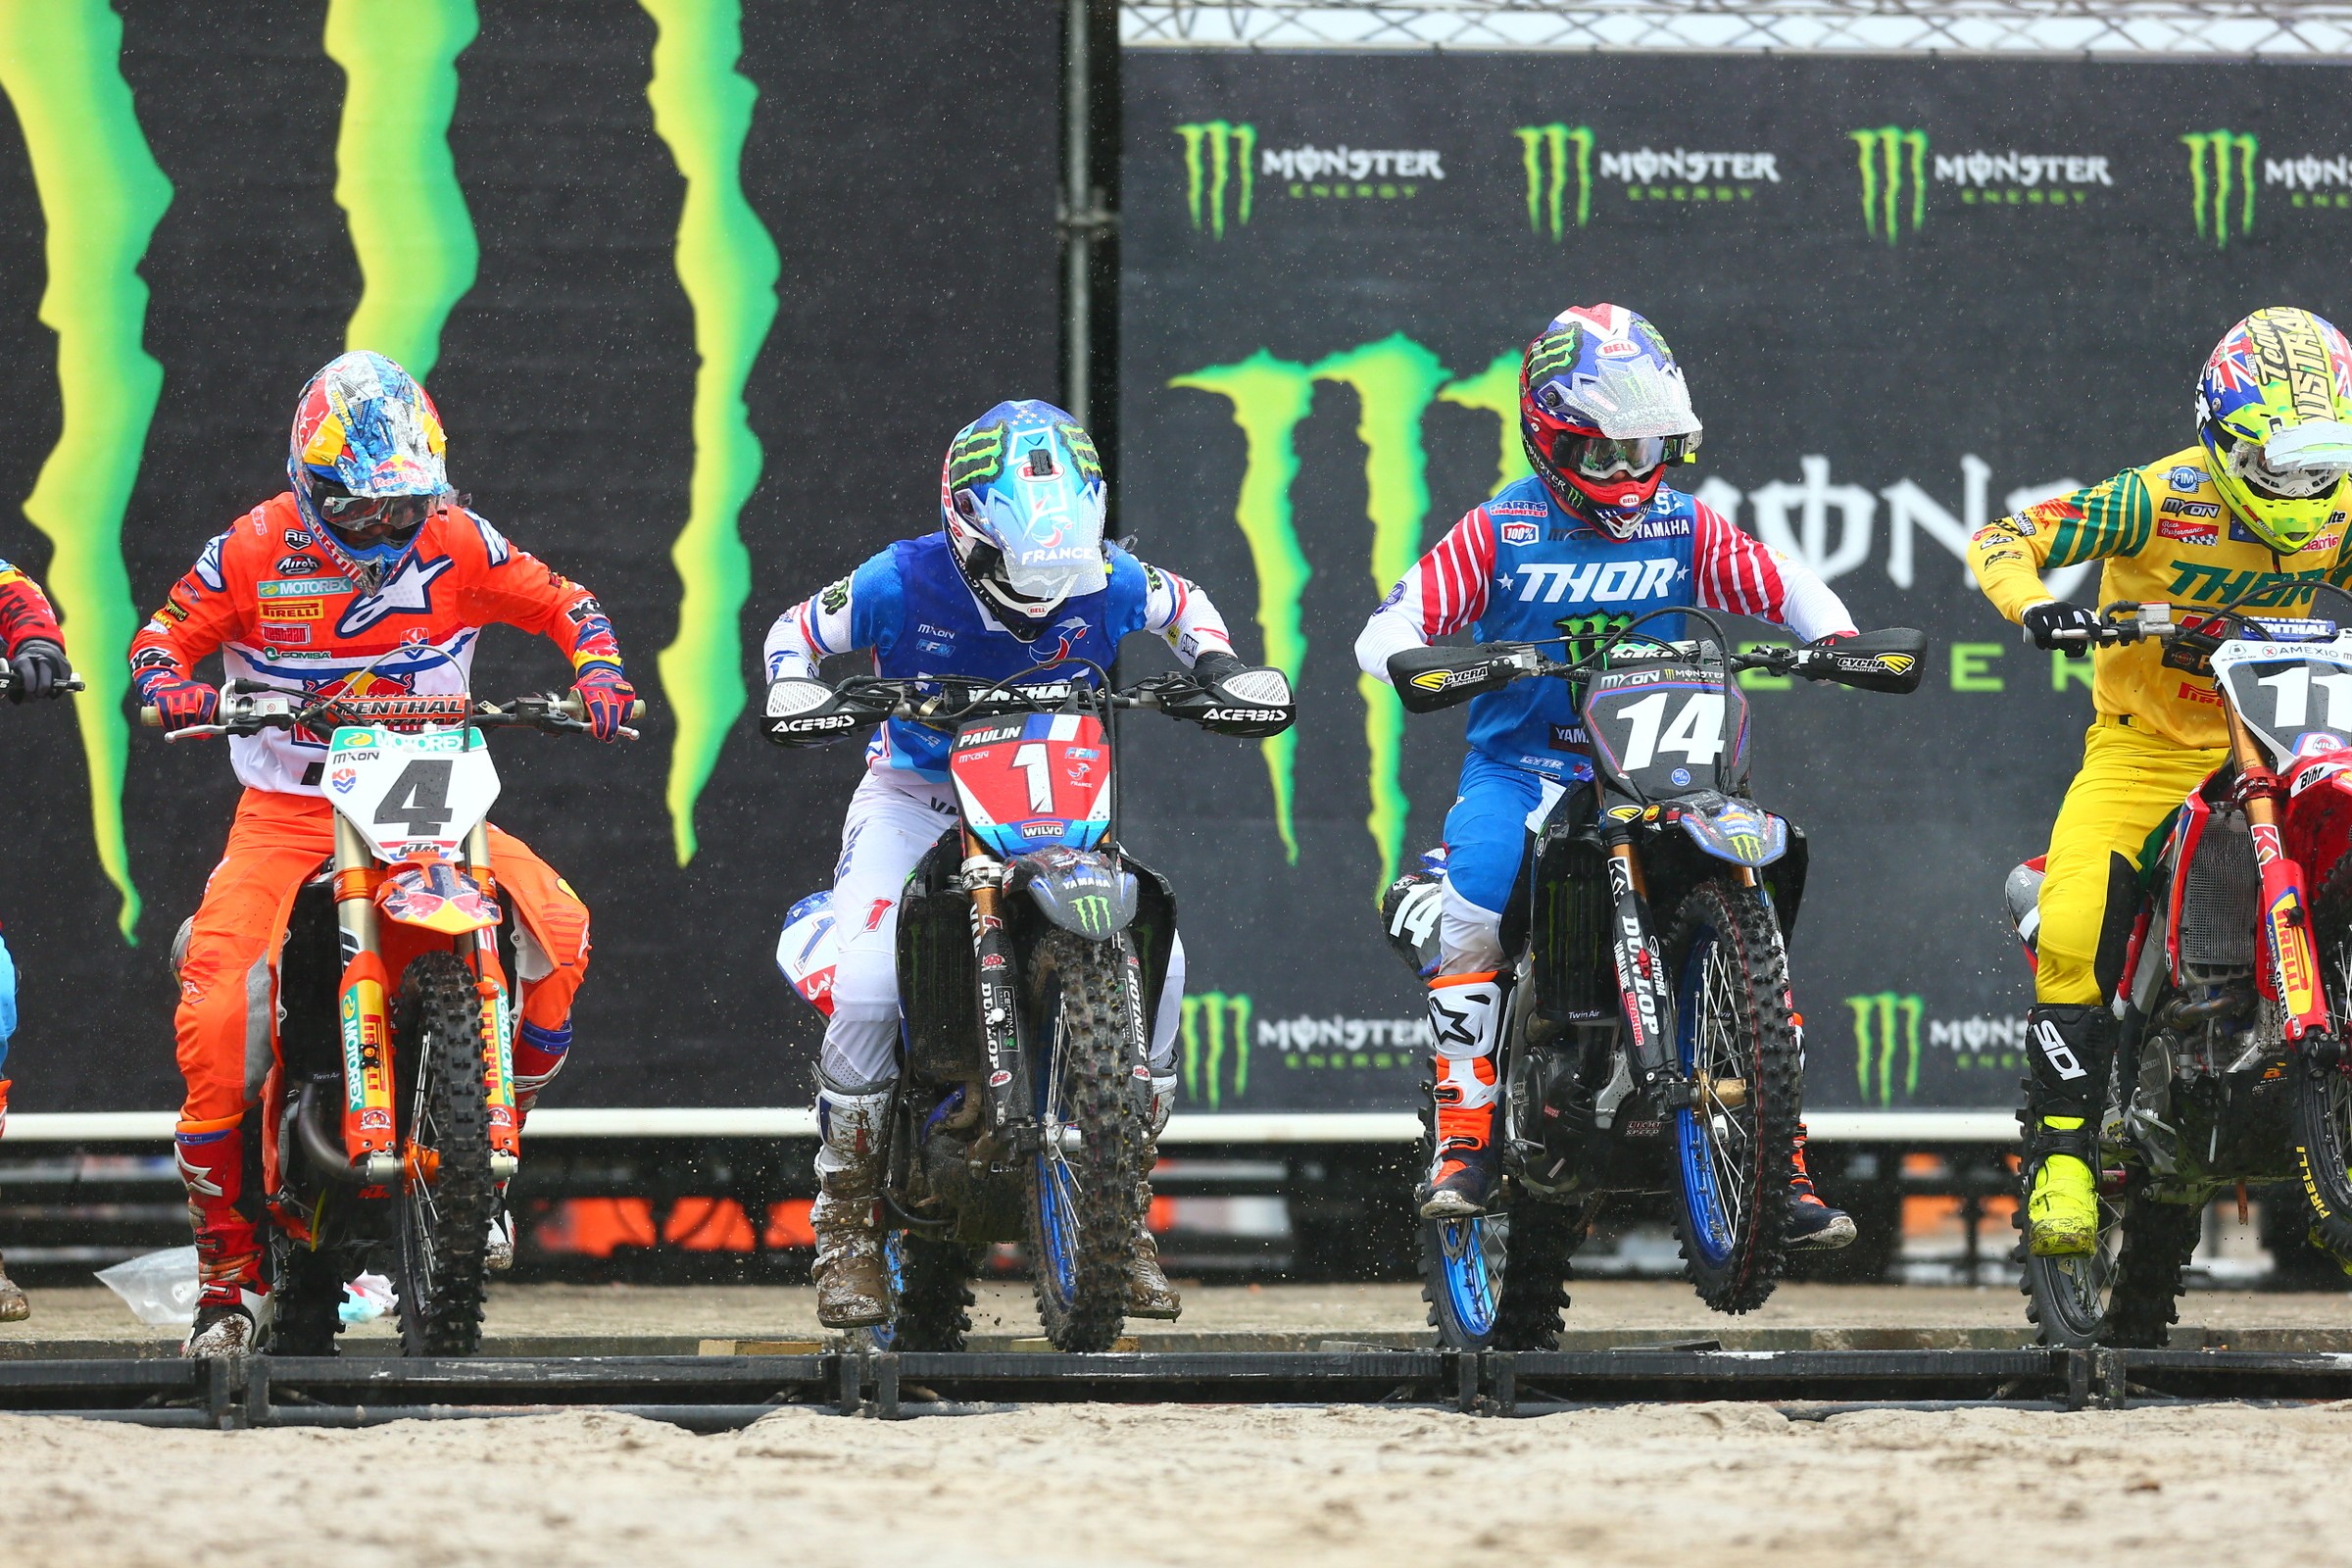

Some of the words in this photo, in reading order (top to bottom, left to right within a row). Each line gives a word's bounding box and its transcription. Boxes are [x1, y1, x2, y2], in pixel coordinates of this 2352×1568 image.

[1262, 146, 1446, 180] MONSTER
[1600, 147, 1781, 183] MONSTER
[1935, 150, 2113, 186] MONSTER
[1603, 343, 1635, 354] BELL
[2268, 307, 2336, 423] USTRAL
[373, 473, 403, 489] Red
[406, 473, 429, 485] Bull
[1023, 467, 1059, 476] BL
[2175, 472, 2194, 484] FIM
[285, 530, 312, 543] RB
[1506, 527, 1534, 540] 100%
[1637, 518, 1690, 538] YAMAHA
[278, 557, 318, 570] Airoh
[1021, 547, 1095, 565] FRANCE
[279, 578, 348, 594] MOTOREX
[1516, 558, 1679, 603] THOR
[2168, 560, 2326, 608] THOR
[262, 602, 320, 617] PIRELLI
[280, 651, 332, 660] COMISA
[1838, 657, 1886, 669] CYCRA
[2279, 645, 2338, 659] AMEXIO
[1445, 667, 1487, 684] CYCRA
[336, 700, 466, 716] RENTHAL
[2258, 666, 2352, 732] 11
[374, 731, 466, 752] MOTOREX
[958, 726, 1022, 748] PAULIN
[1616, 692, 1726, 771] 14
[1011, 743, 1054, 813] 1
[2299, 765, 2326, 790] Bihr
[373, 760, 454, 837] 4
[1024, 827, 1063, 837] WILVO
[1725, 827, 1757, 836] YAMAHA
[399, 842, 440, 857] KTM
[1061, 877, 1111, 891] YAMAHA
[1390, 882, 1443, 949] 14
[2275, 909, 2309, 994] PIRELLI
[1614, 940, 1632, 993] YAMALUBE
[1622, 915, 1660, 1036] DUNLOP
[1650, 957, 1667, 997] CYCRA
[2275, 970, 2290, 1025] GALFER
[981, 982, 1000, 1070] DUNLOP
[1127, 968, 1148, 1061] DUNLOP
[1568, 1010, 1588, 1019] Twin
[1627, 993, 1644, 1047] BRAKING
[496, 993, 515, 1083] MOTOREX
[344, 1019, 364, 1107] MOTOREX
[364, 1013, 387, 1093] PIRLLI
[2295, 1146, 2332, 1220] PIRELLI
